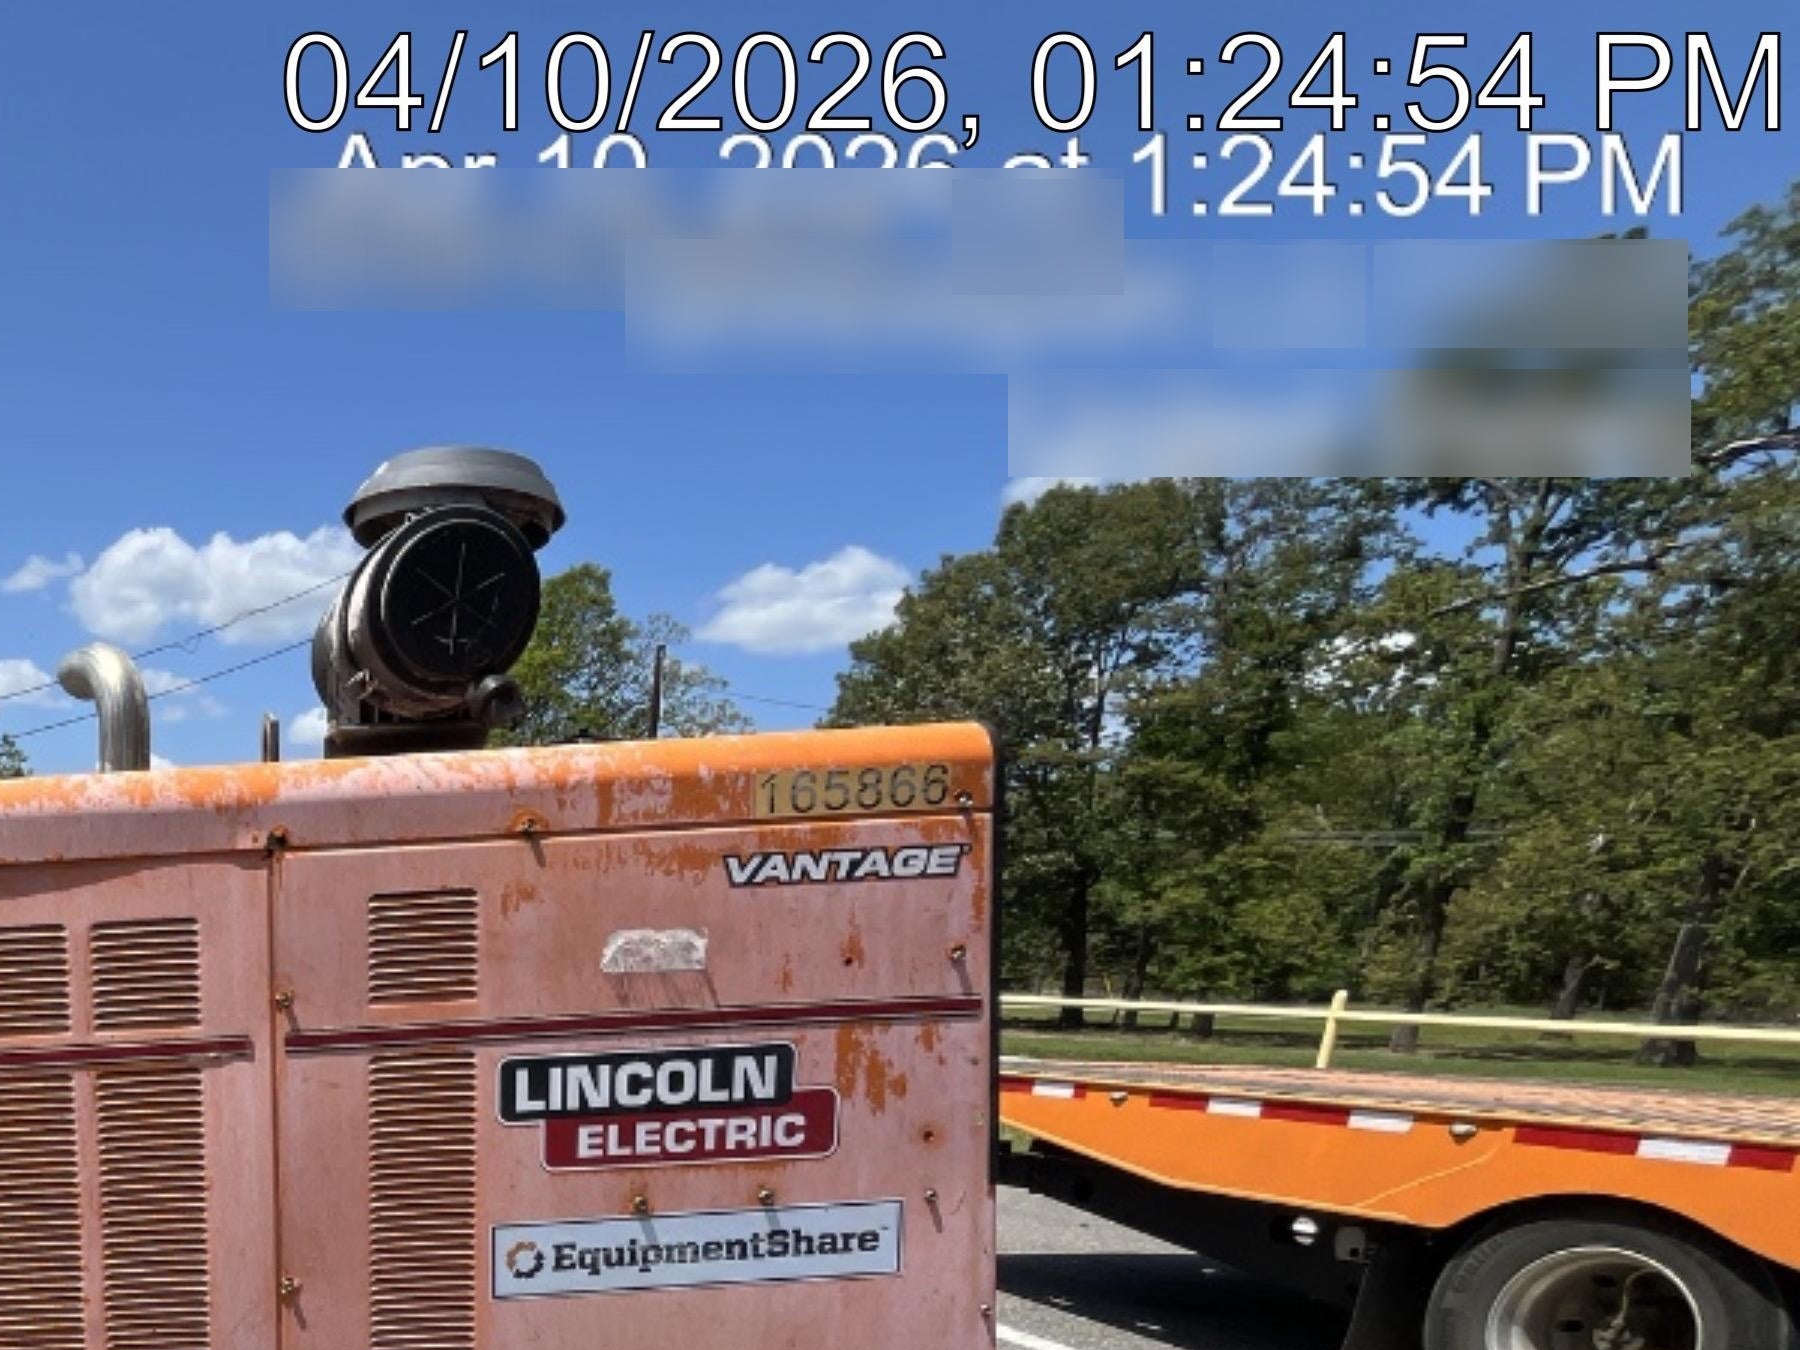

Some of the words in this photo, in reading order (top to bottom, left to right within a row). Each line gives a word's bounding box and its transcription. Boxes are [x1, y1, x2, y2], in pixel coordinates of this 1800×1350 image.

[760, 764, 950, 814] 165866
[724, 845, 962, 885] VANTAGE
[514, 1054, 778, 1113] LINCOLN
[576, 1113, 807, 1159] ELECTRIC
[551, 1226, 882, 1276] EquipmentShare
